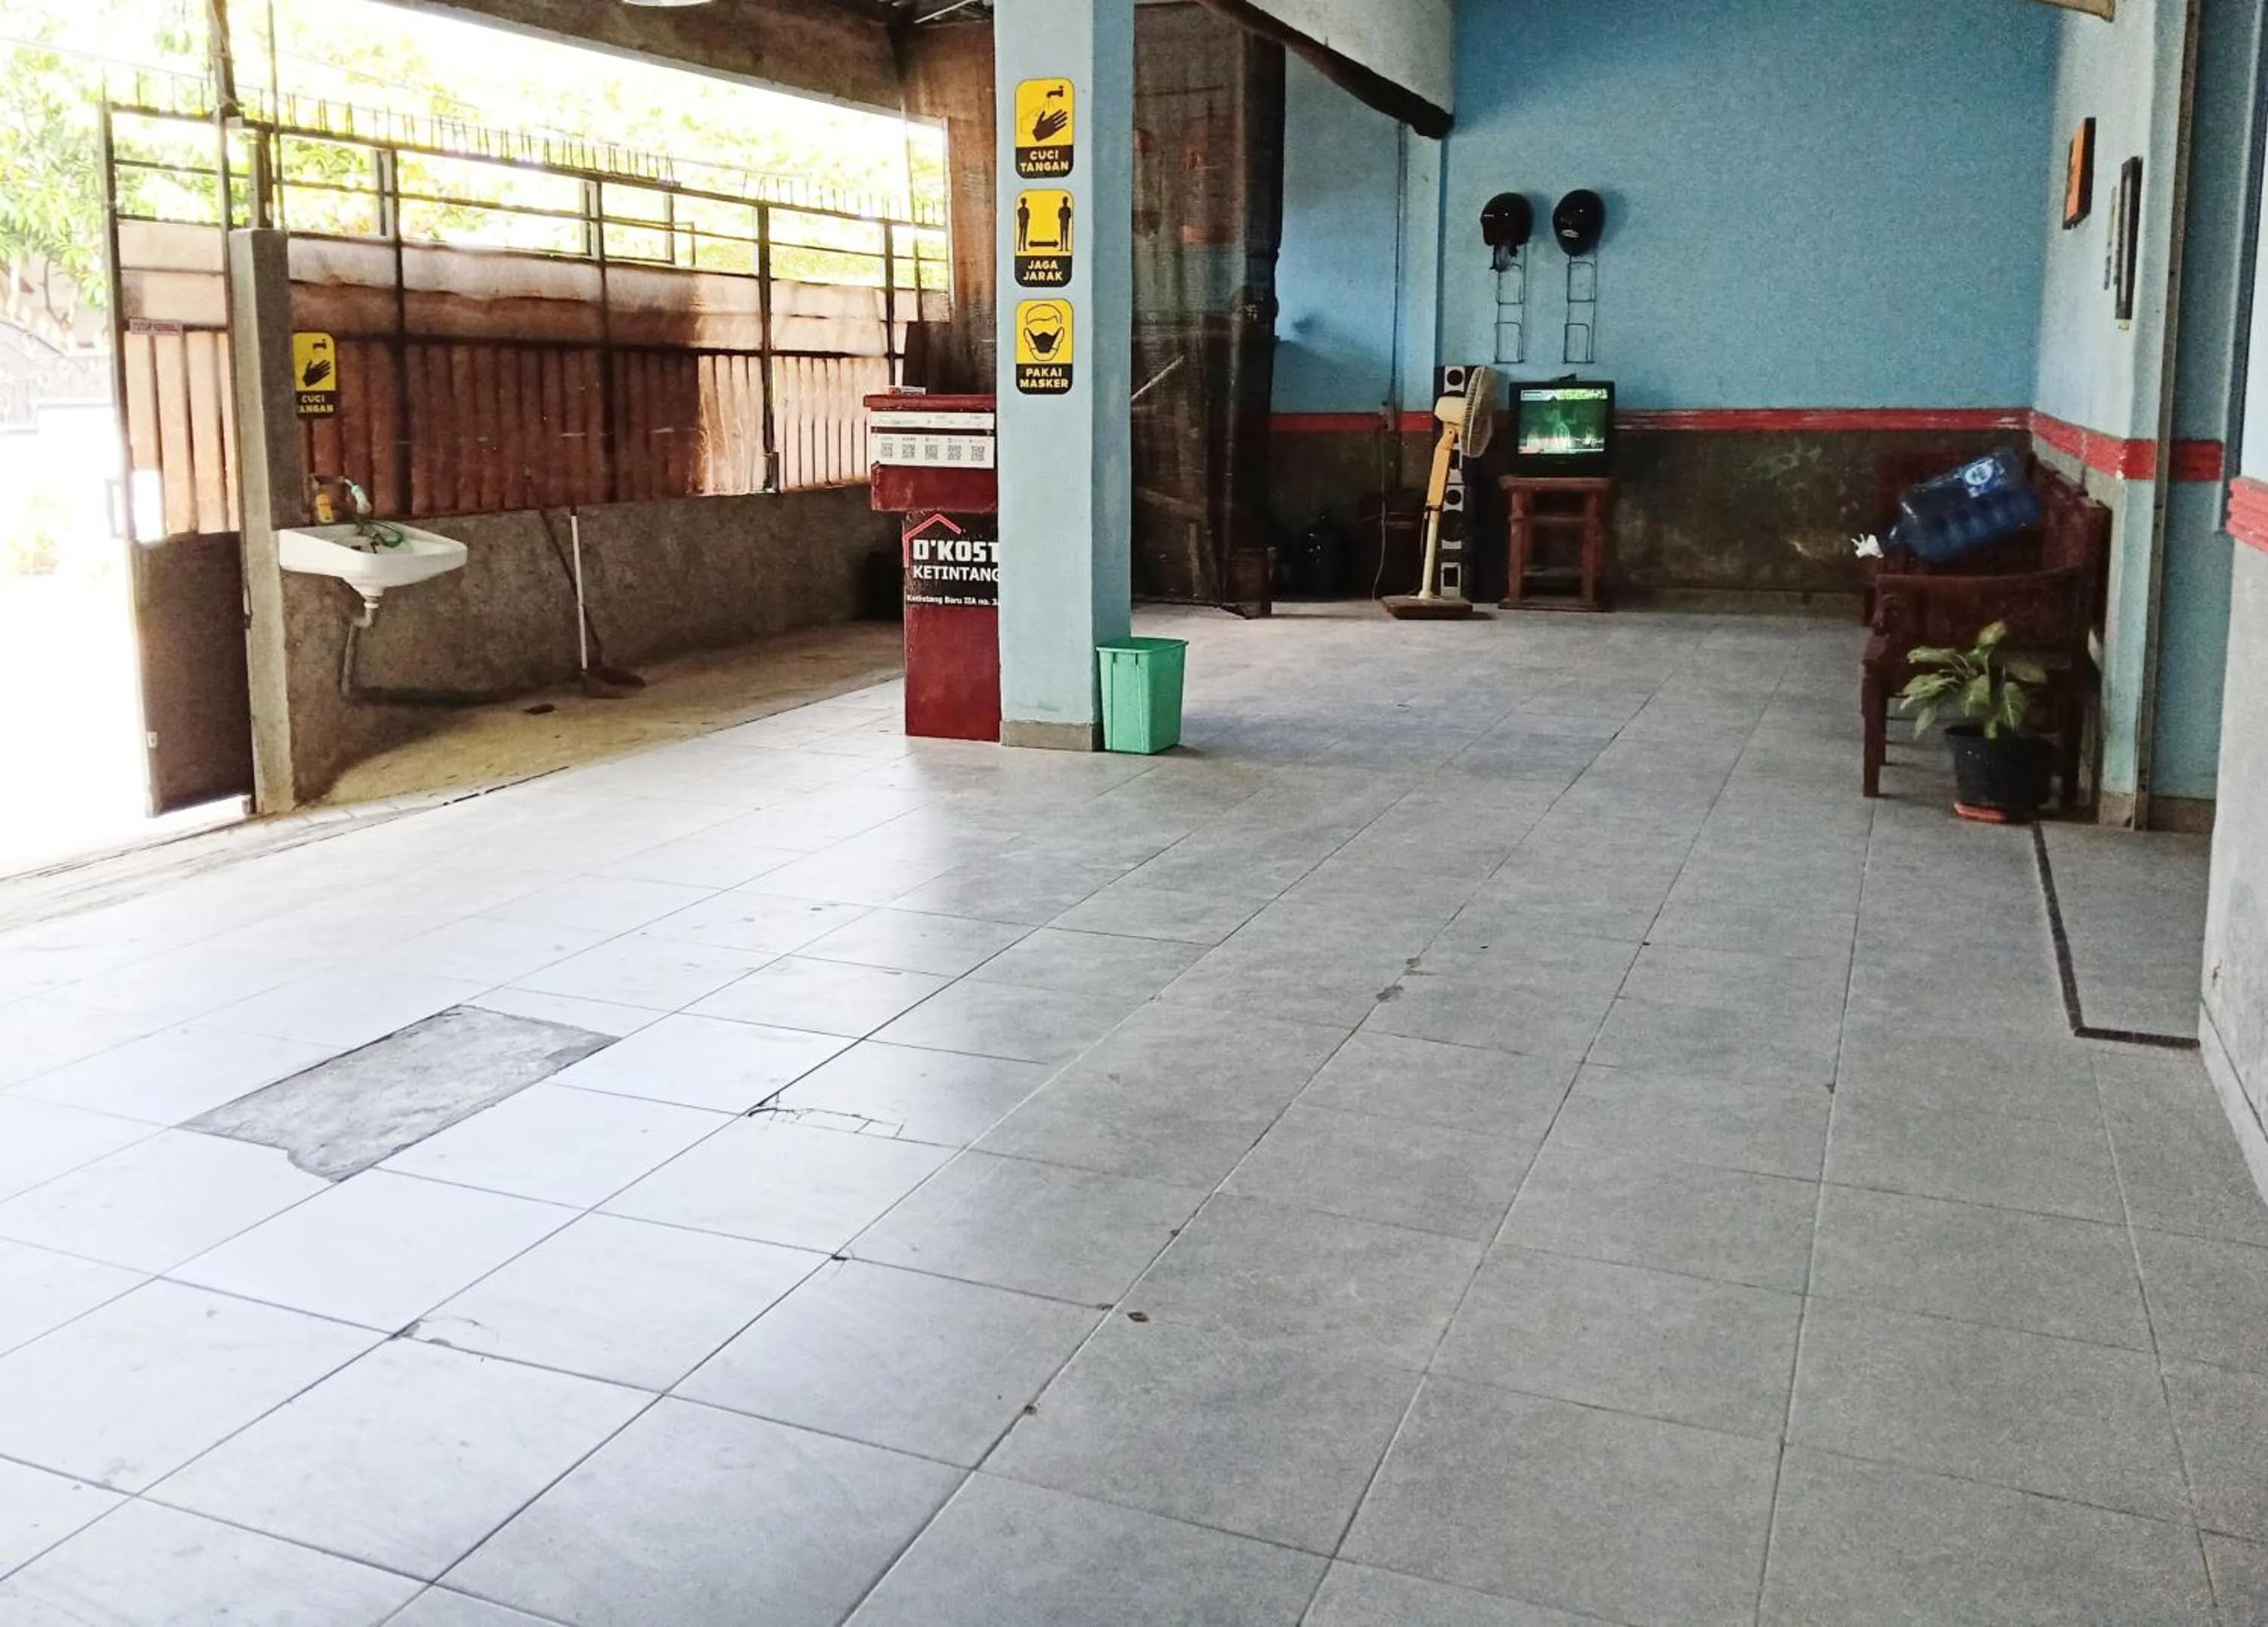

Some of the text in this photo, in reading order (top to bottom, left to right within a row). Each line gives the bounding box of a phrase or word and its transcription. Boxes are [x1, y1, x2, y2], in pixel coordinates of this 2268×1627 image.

[1029, 149, 1059, 160] CUCI
[1020, 160, 1069, 172] TANGAN
[1028, 259, 1058, 270] JAGA
[1023, 271, 1063, 281] JARAK
[1026, 367, 1062, 377] PAKAI
[1020, 379, 1068, 388] MASKER
[302, 394, 325, 403] CUCI
[298, 404, 334, 413] ANGAN
[944, 596, 962, 604] Baru
